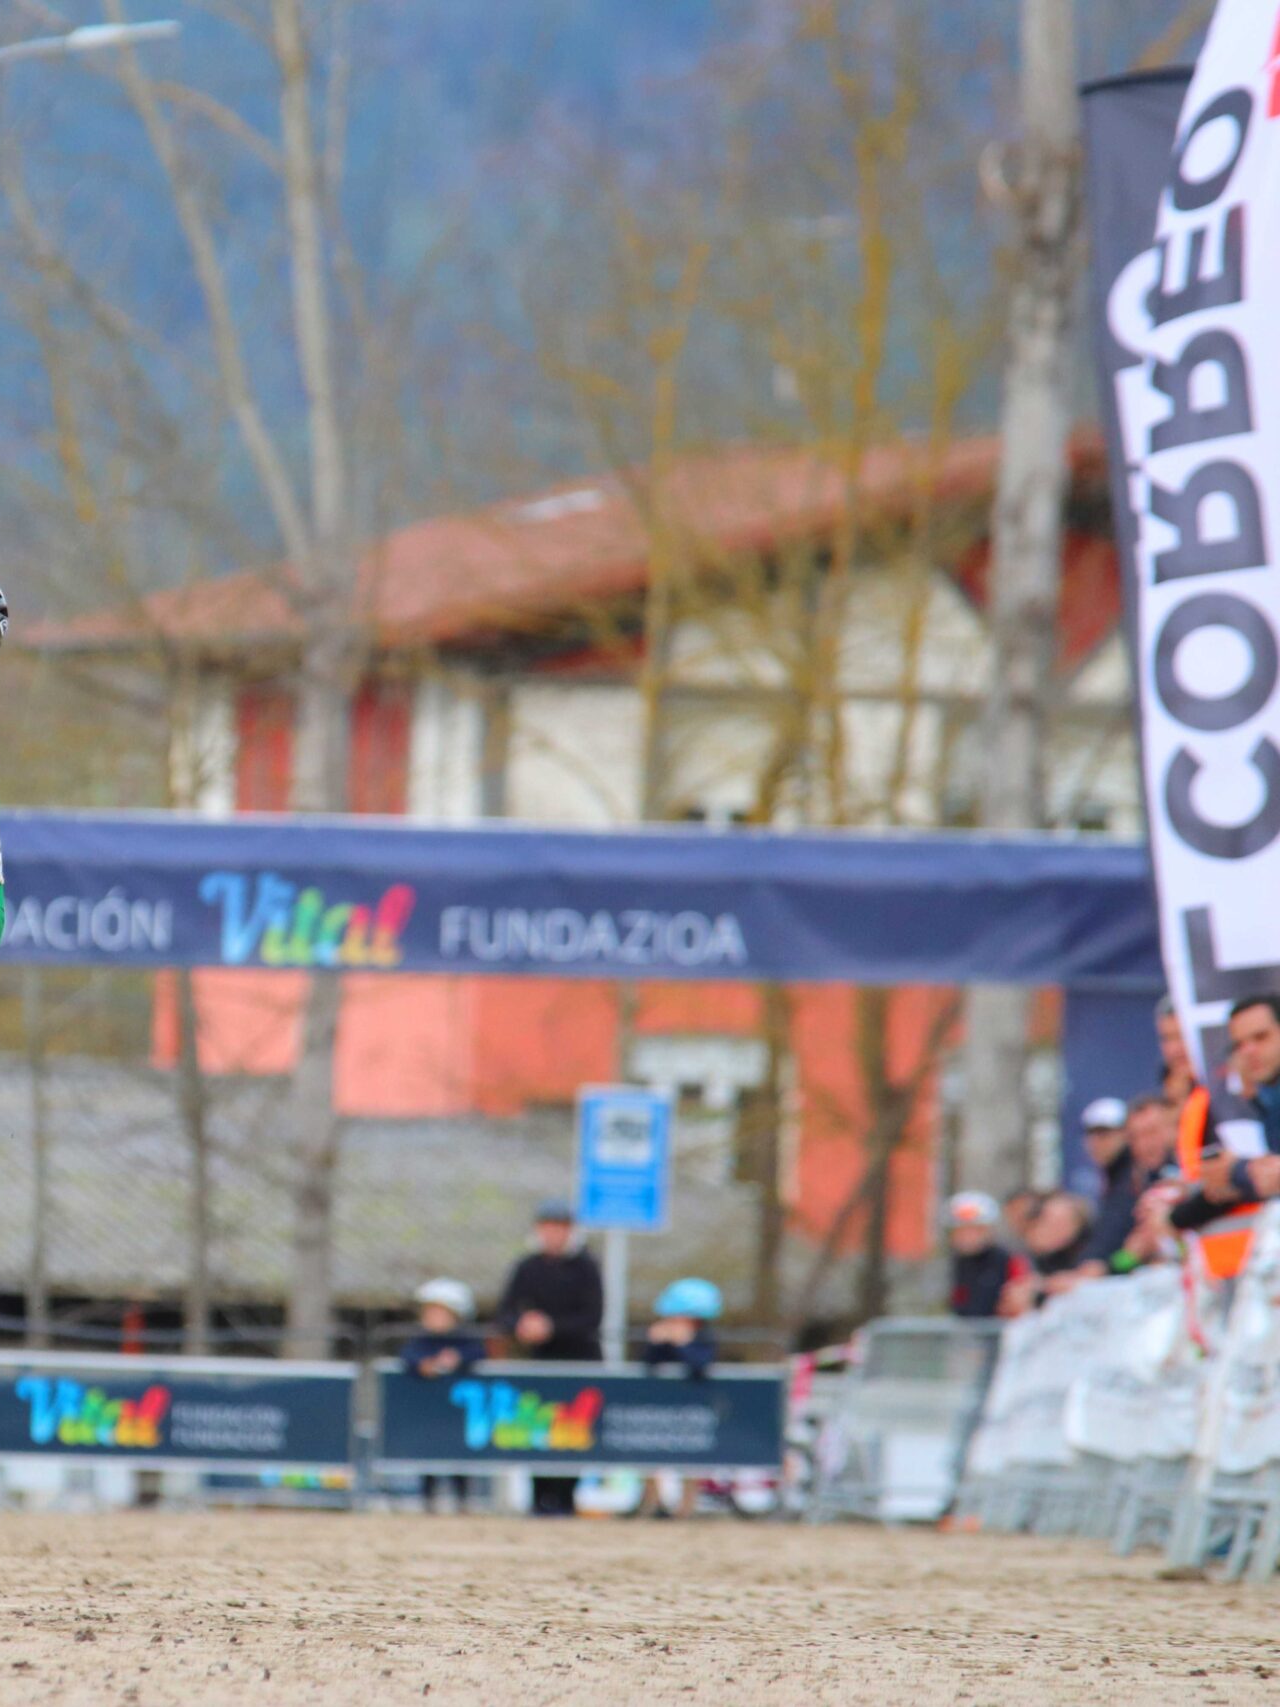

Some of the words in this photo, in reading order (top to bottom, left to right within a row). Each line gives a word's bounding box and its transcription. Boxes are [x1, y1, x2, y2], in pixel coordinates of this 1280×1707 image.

[4, 886, 173, 952] ACIÓN
[198, 869, 417, 967] Vital
[440, 905, 748, 967] FUNDAZIOA
[15, 1375, 170, 1446] Vital
[450, 1379, 604, 1450] Vital
